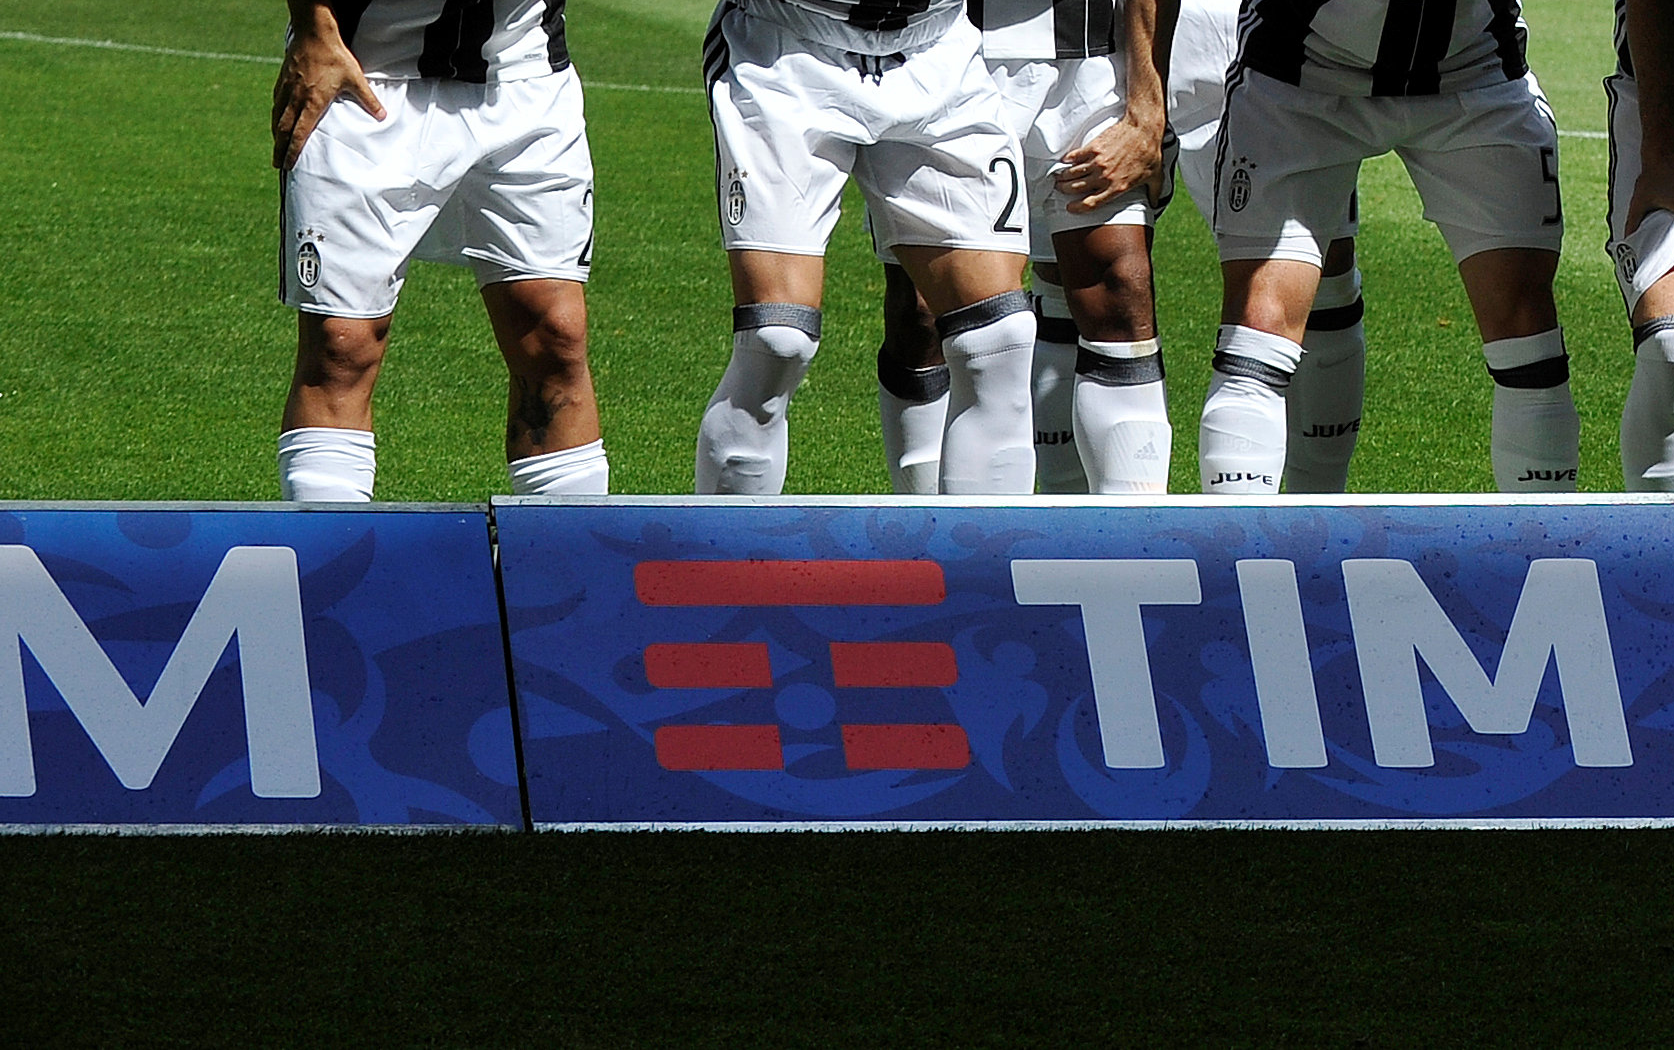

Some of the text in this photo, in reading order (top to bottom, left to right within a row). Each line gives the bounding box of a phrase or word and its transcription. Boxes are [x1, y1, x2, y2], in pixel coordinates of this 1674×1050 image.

[988, 157, 1023, 233] 2
[1539, 146, 1563, 227] 5
[1034, 430, 1074, 445] JUV
[1210, 472, 1274, 486] JUVE
[1518, 468, 1577, 482] JUVE
[1009, 557, 1634, 770] TIM
